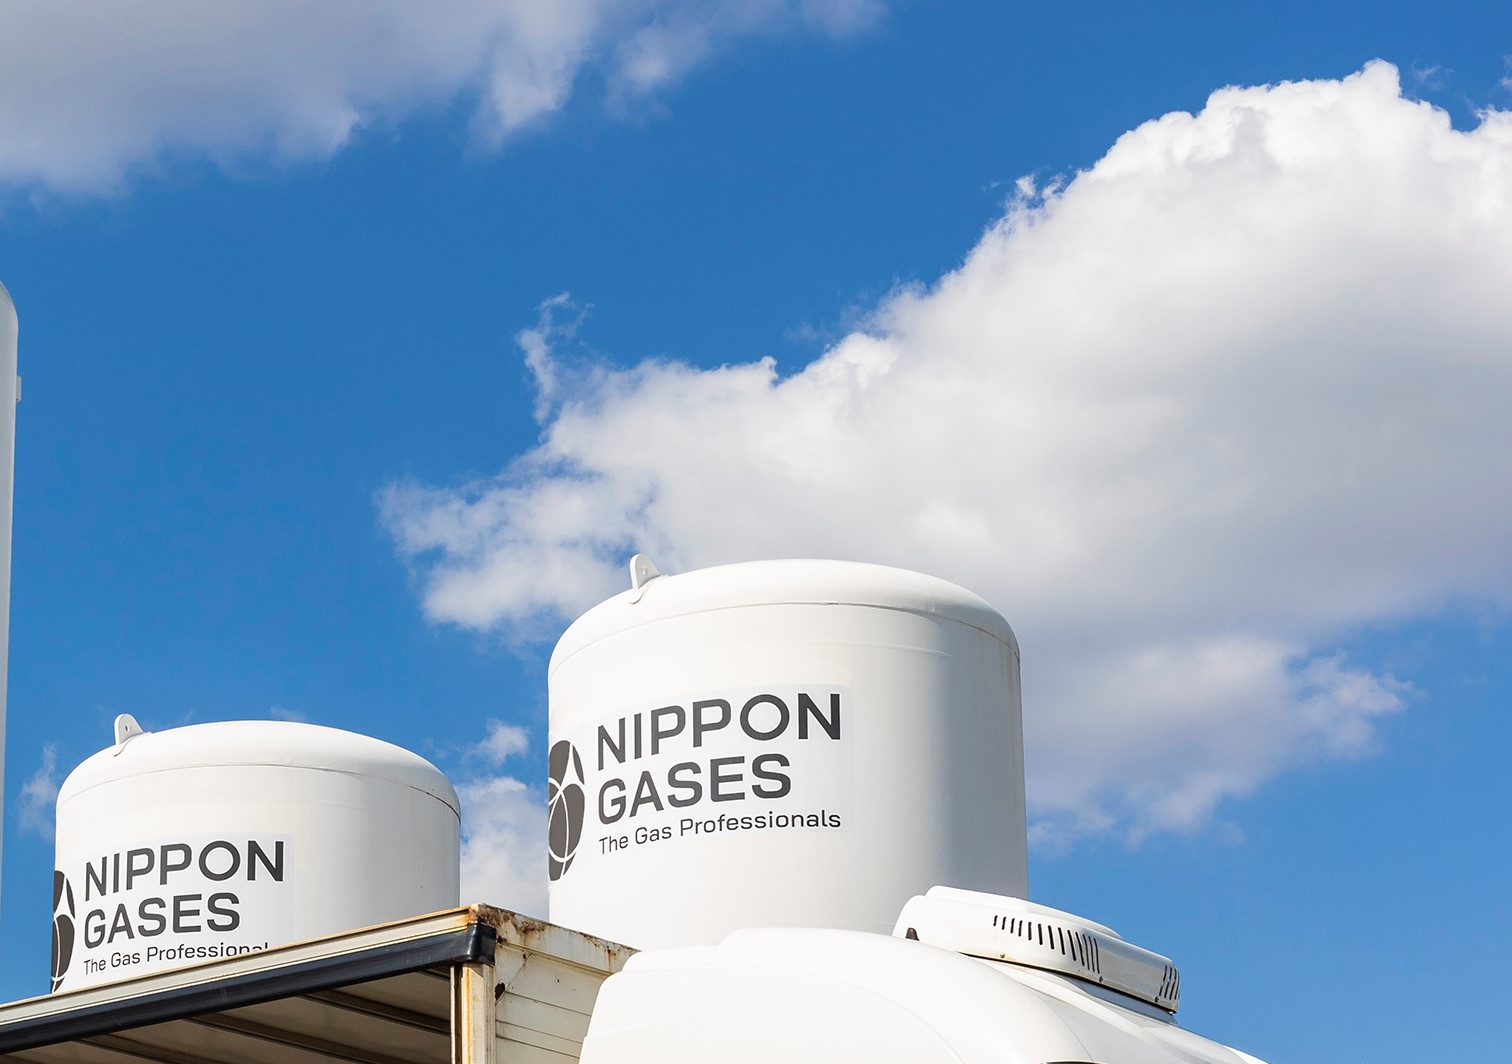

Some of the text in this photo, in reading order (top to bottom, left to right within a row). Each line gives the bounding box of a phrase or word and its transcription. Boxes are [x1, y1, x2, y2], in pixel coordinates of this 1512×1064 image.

[598, 693, 841, 771] NIPPON
[598, 753, 791, 825] GASES
[599, 810, 841, 855] The Gas Professionals
[85, 840, 284, 901] NIPPON
[84, 892, 240, 949] GASES
[84, 958, 106, 975] The
[111, 952, 140, 968] Gas
